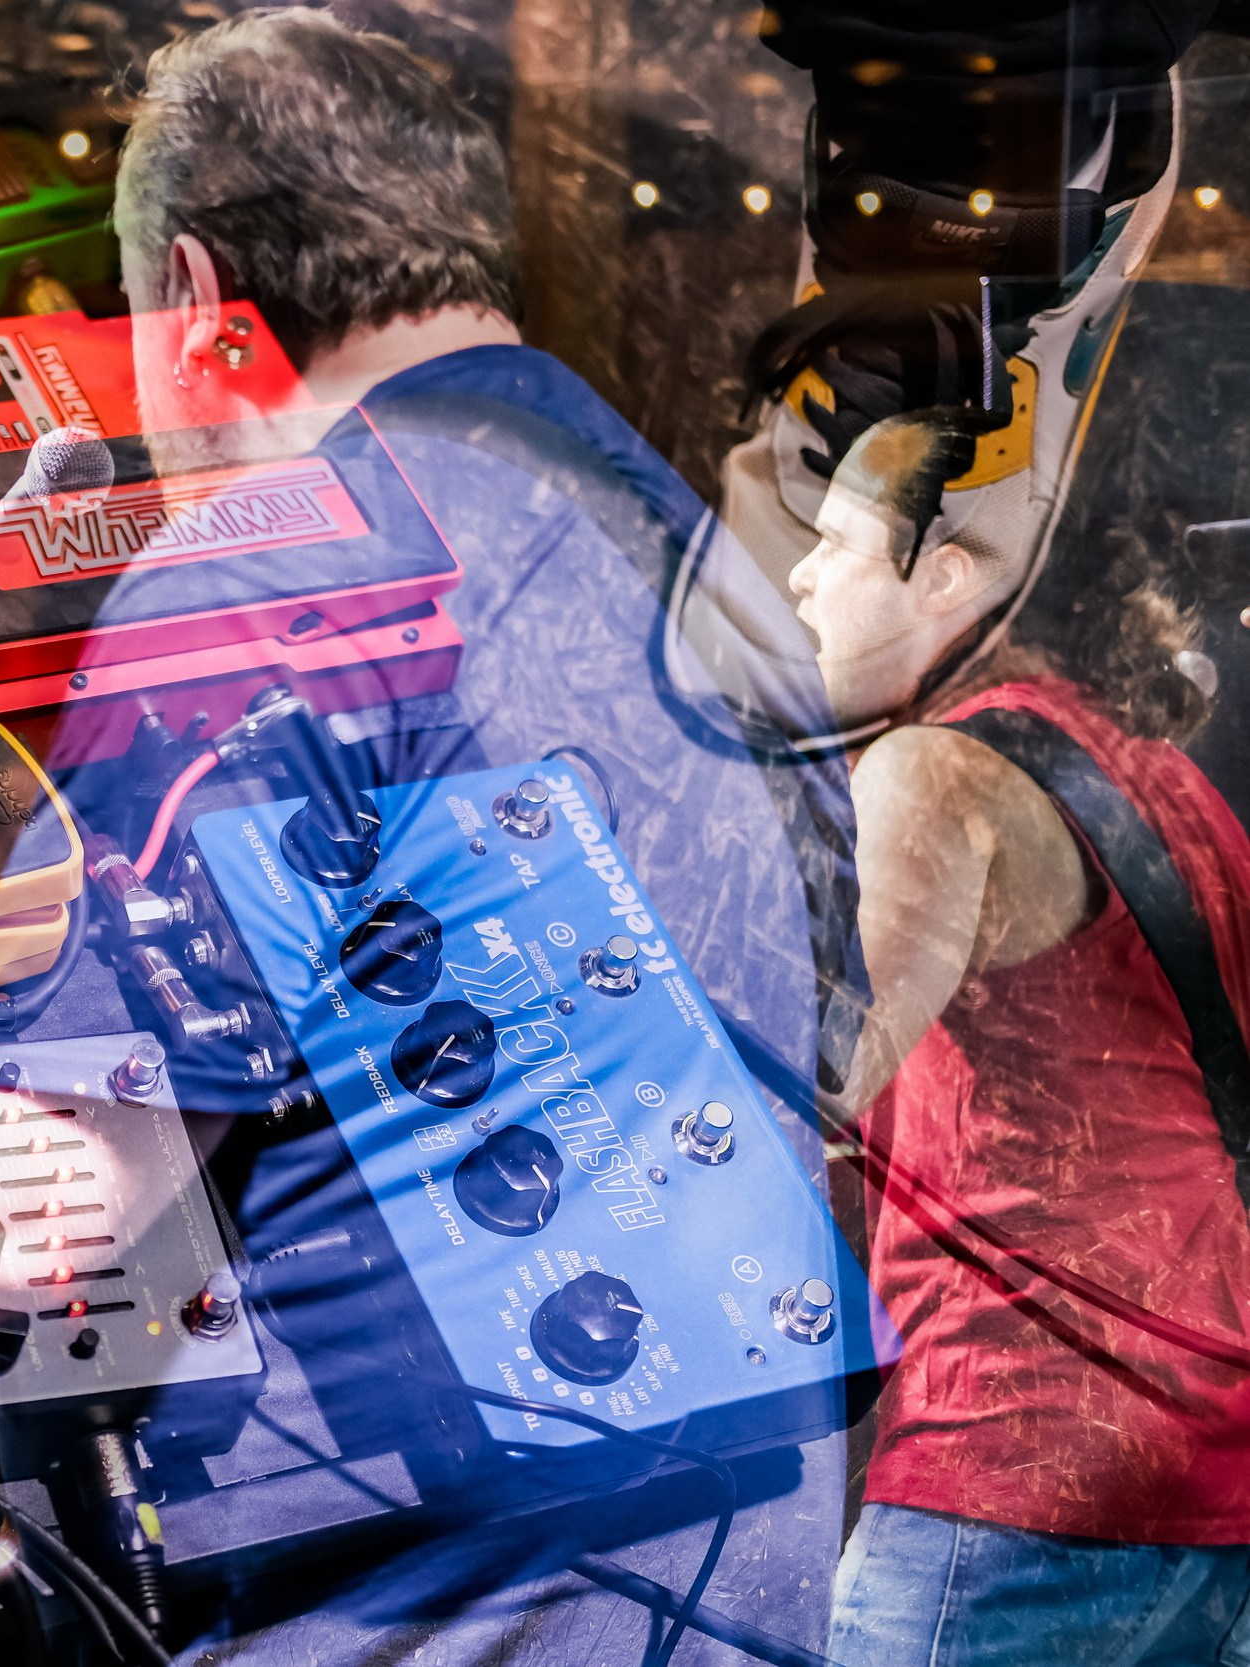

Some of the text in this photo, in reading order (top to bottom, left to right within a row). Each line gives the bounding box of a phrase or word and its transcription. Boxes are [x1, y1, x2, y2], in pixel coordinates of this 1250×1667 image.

[445, 796, 477, 838] UNDO
[241, 820, 292, 904] LOOPER LEVEL
[510, 853, 541, 890] TAP
[545, 773, 677, 974] tc electronic
[318, 893, 345, 933] LOOPER
[524, 940, 557, 982] ONCE
[303, 939, 351, 1019] DELAY LEVEL
[672, 975, 693, 1010] LOOPER
[661, 977, 694, 1026] TRUE BYPASS
[699, 1020, 720, 1050] DELAY
[354, 1045, 398, 1114] FEEDBACK
[445, 950, 665, 1231] FLASHBACK
[150, 1112, 172, 1162] ULTRA
[167, 1166, 177, 1177] X
[416, 1168, 466, 1246] DELAY TIME
[516, 1264, 538, 1291] SPACE
[534, 1249, 558, 1282] ANALOG
[504, 1286, 523, 1309] TUBE
[717, 1292, 746, 1325] REC
[499, 1310, 518, 1331] TAPE
[643, 1314, 660, 1334] 2290
[649, 1351, 668, 1371] 2290
[657, 1343, 675, 1362] MOD
[633, 1386, 652, 1406] LOFI
[643, 1370, 663, 1392] SLAP
[606, 1396, 625, 1417] PING
[617, 1392, 637, 1417] PONG
